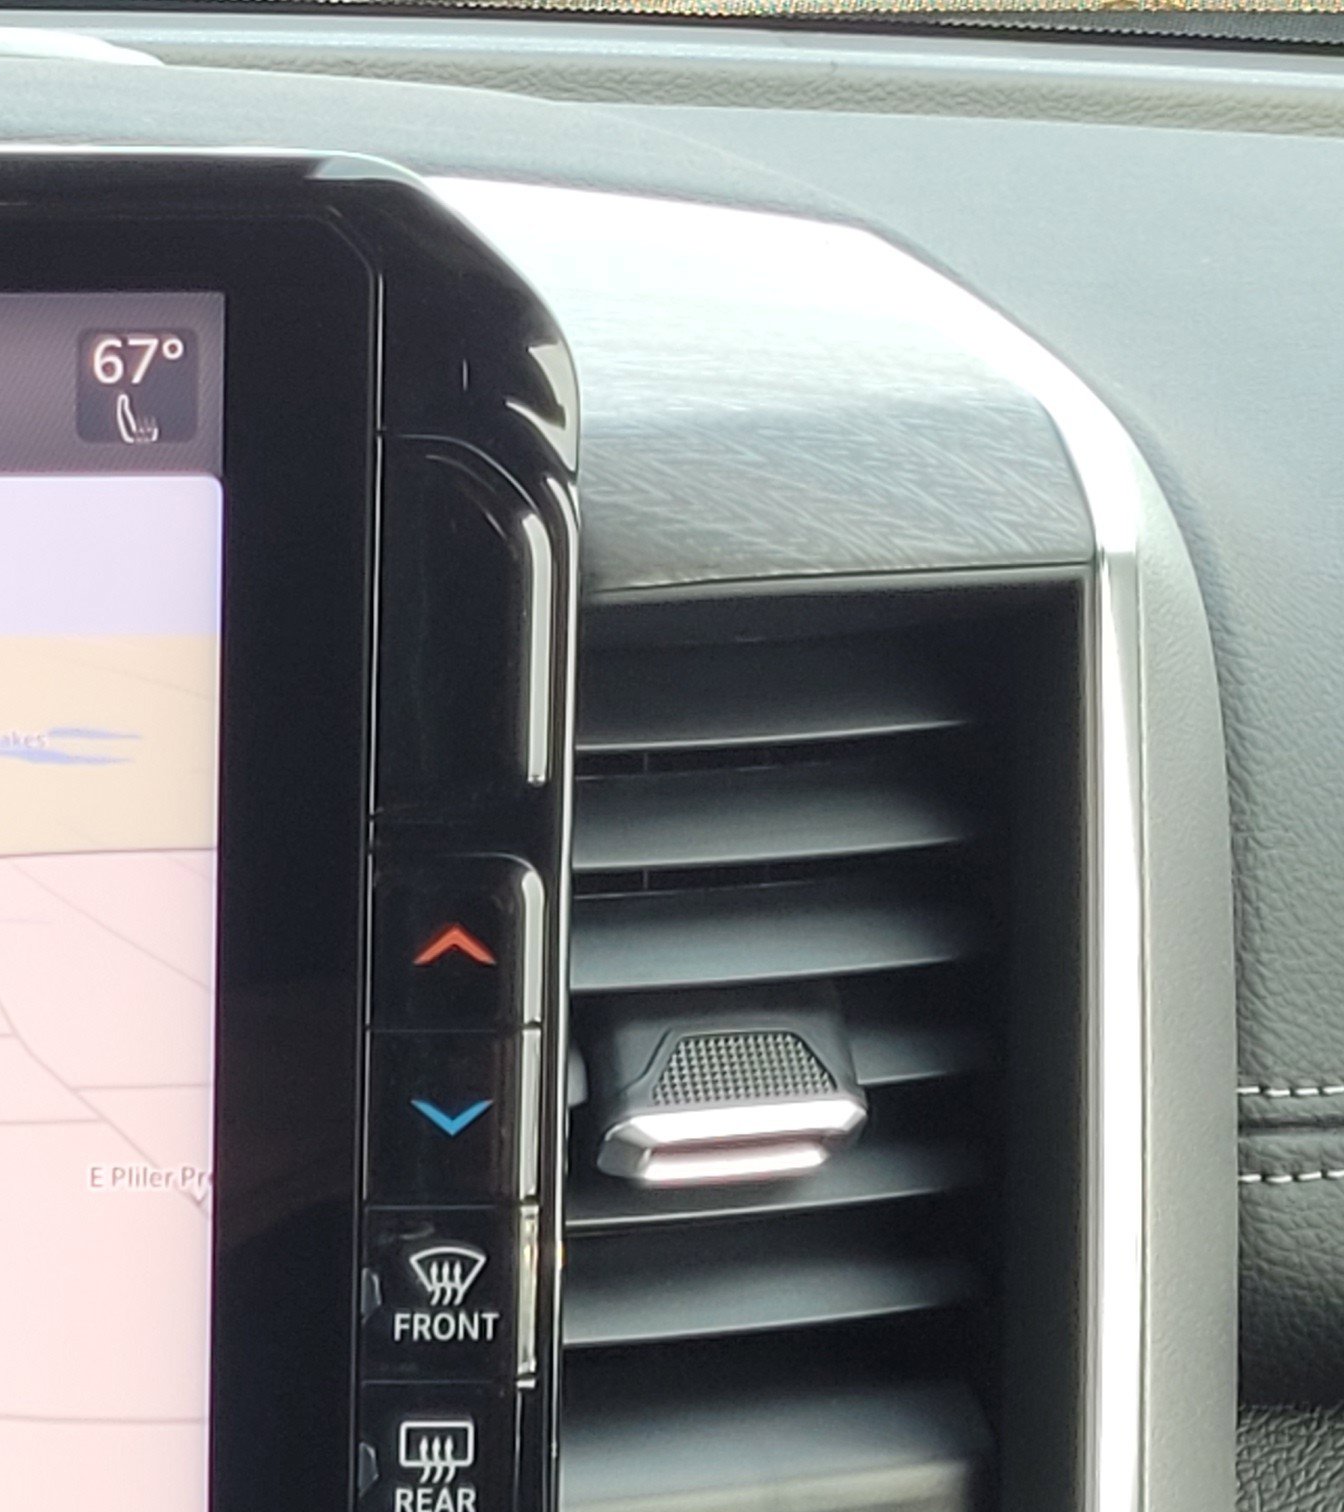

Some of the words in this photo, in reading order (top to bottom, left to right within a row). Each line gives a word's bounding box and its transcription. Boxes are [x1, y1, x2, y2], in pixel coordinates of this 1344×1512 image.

[91, 337, 184, 385] 67°
[90, 1166, 103, 1188] E
[112, 1166, 174, 1188] Pliler
[393, 1312, 500, 1341] FRONT
